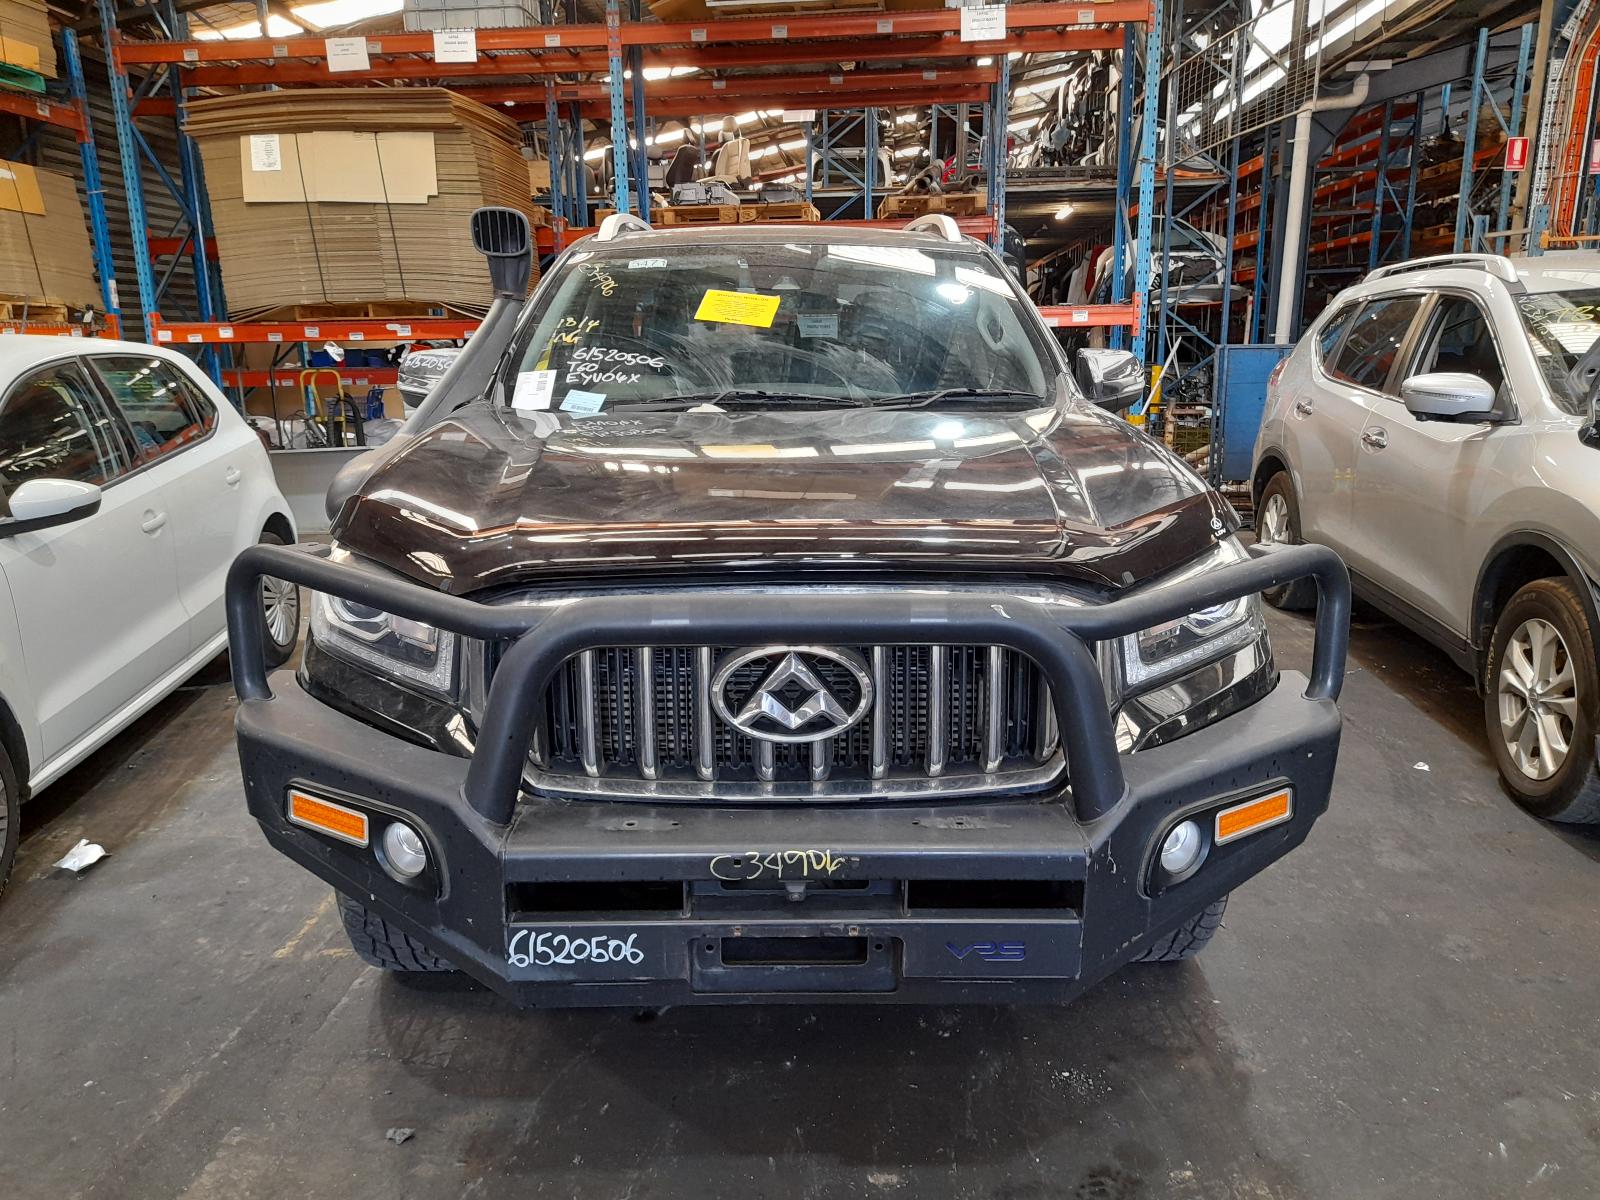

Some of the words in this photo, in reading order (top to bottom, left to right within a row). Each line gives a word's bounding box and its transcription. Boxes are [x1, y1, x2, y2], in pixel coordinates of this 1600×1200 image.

[566, 361, 599, 373] T60
[572, 346, 665, 368] 61520506
[507, 929, 645, 968] 61520506
[944, 941, 1026, 962] VRS
